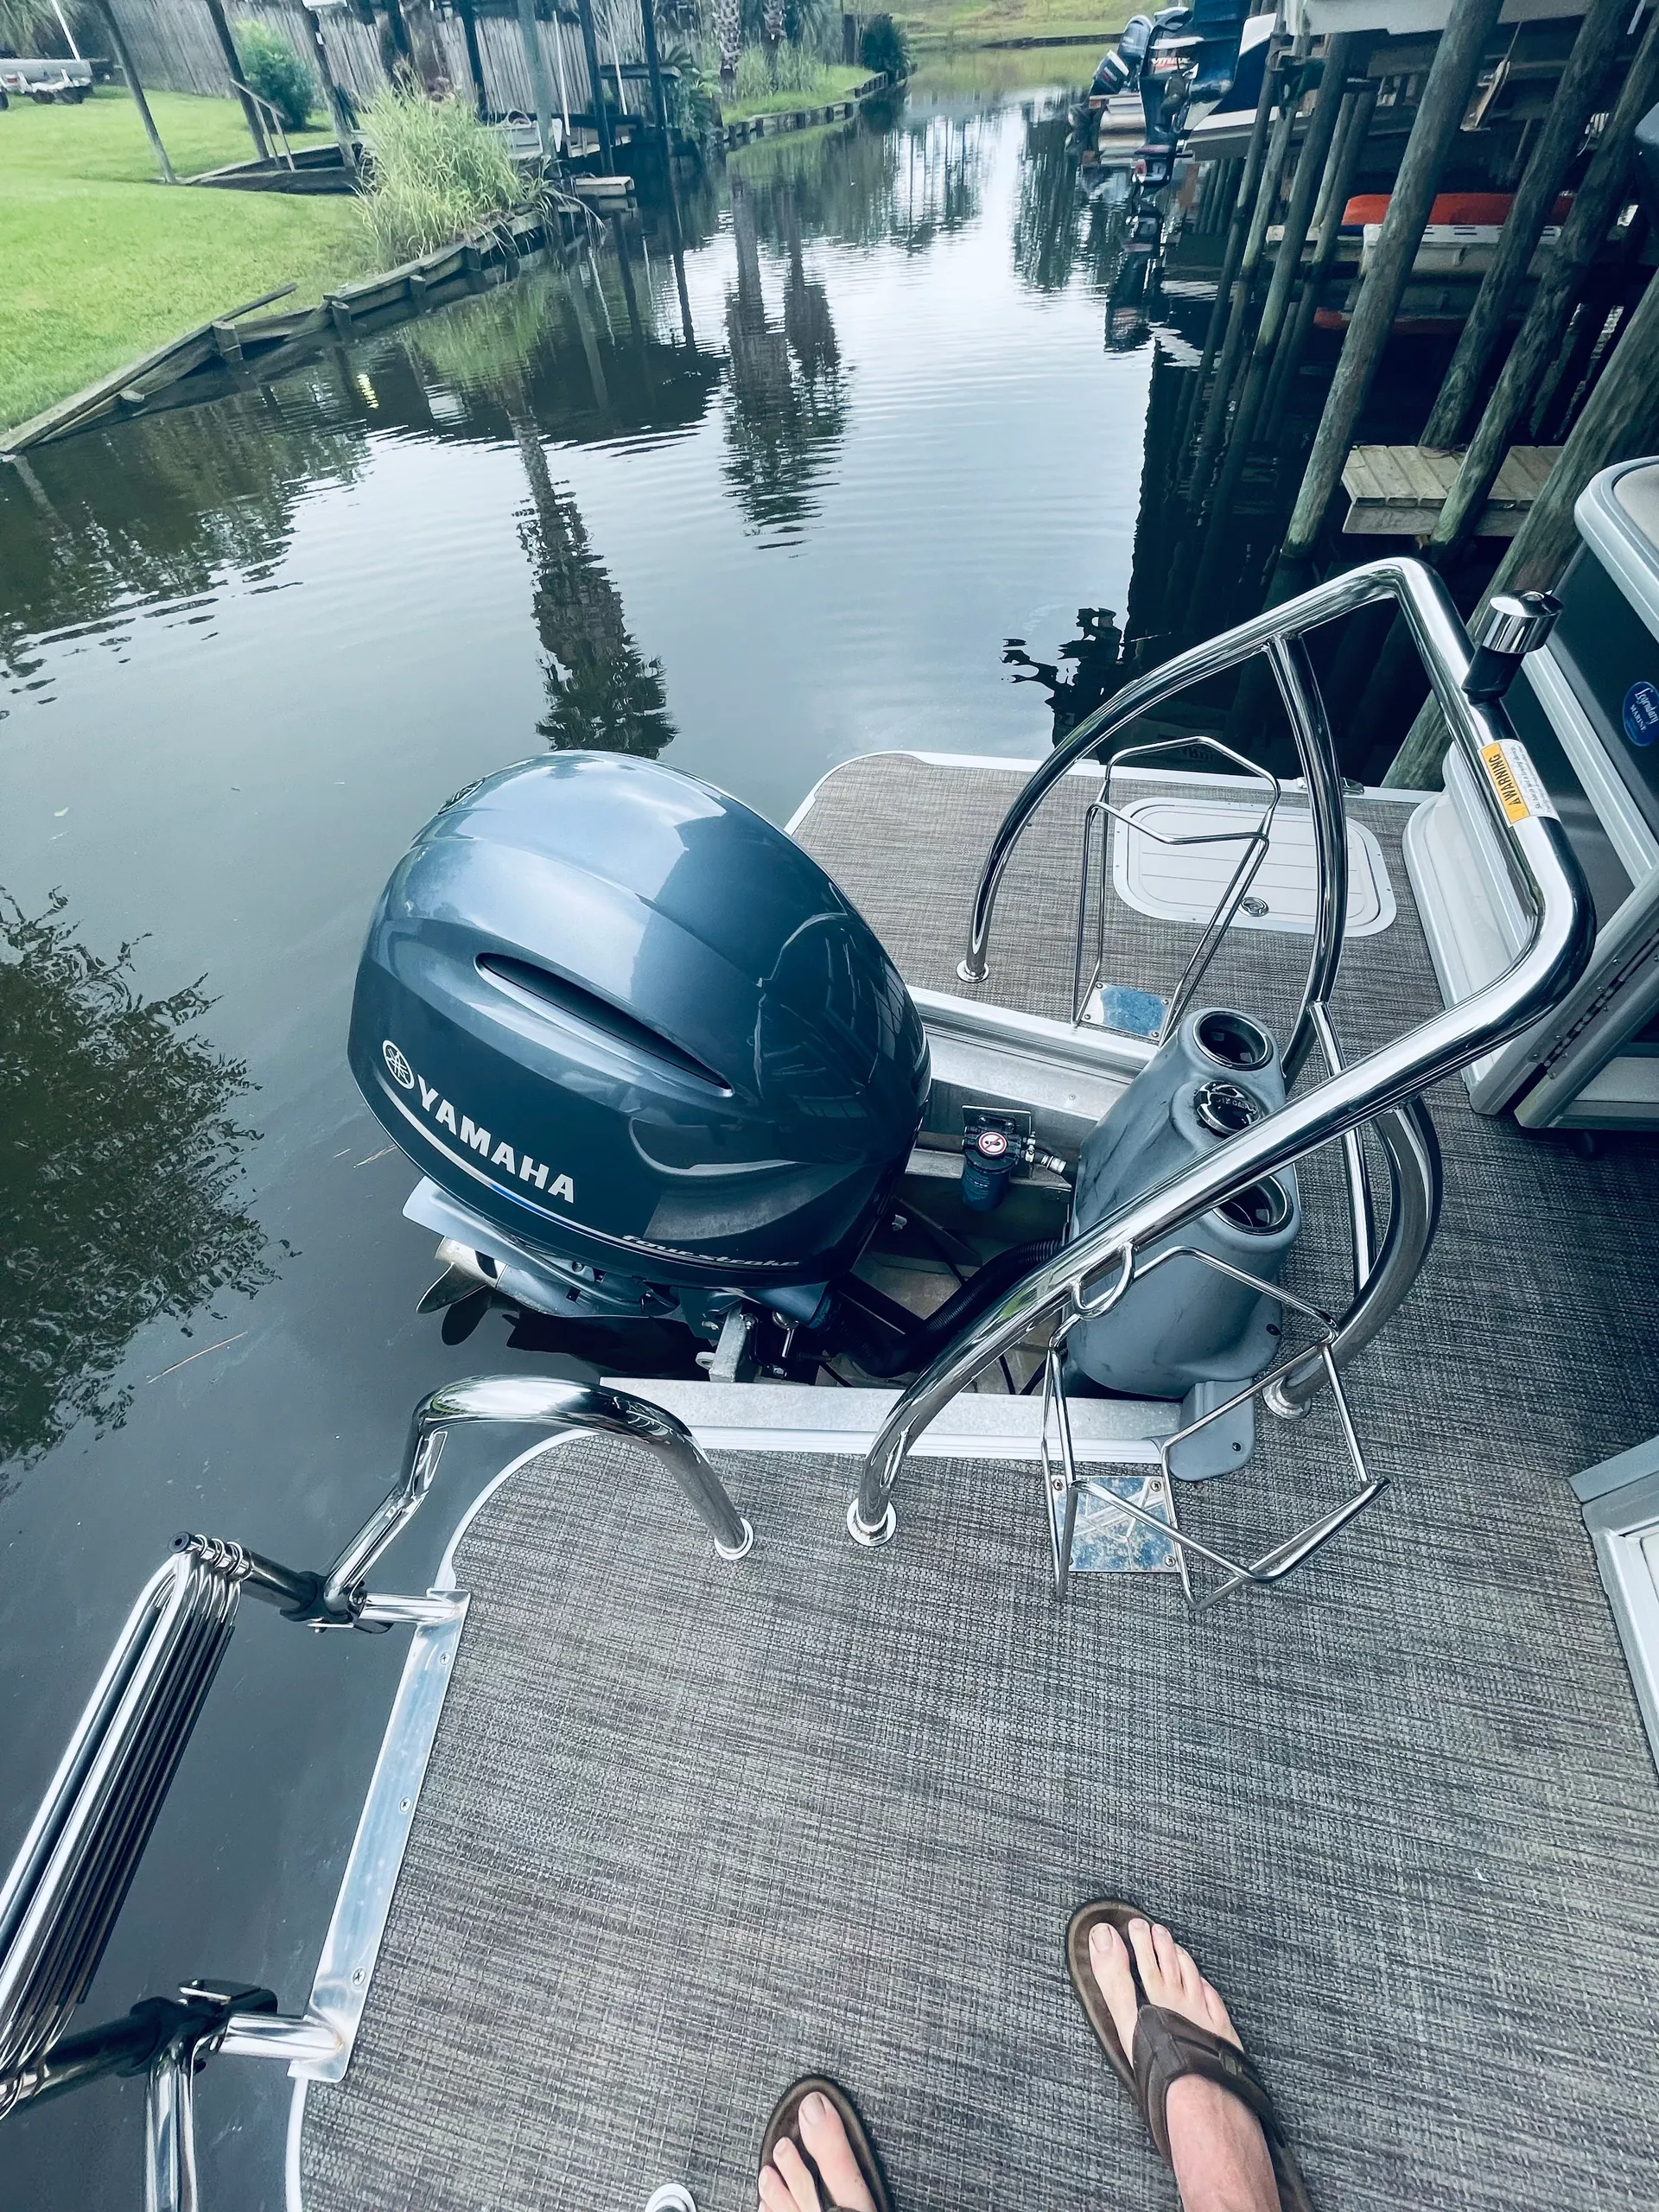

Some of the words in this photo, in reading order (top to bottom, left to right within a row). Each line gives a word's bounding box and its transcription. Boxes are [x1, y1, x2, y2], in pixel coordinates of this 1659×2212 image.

[1630, 704, 1647, 731] MARINE
[1635, 688, 1659, 725] Legendary
[1488, 753, 1518, 801] WARNING
[417, 1074, 574, 1204] YAMAHA
